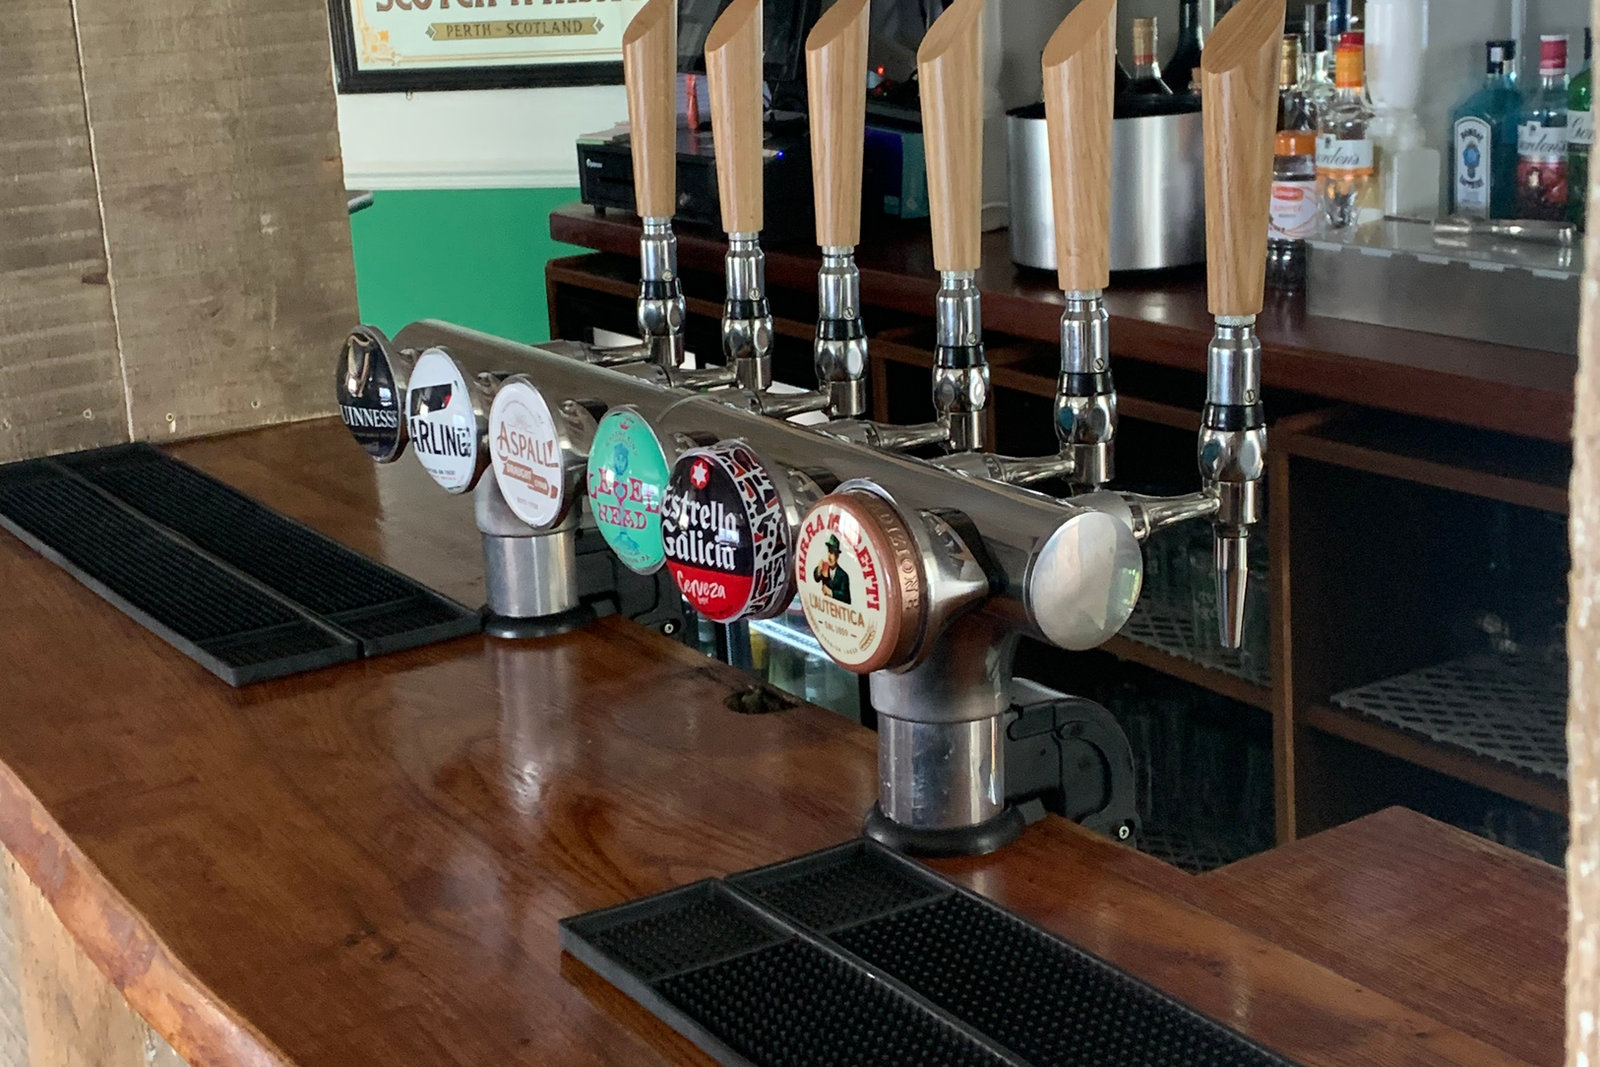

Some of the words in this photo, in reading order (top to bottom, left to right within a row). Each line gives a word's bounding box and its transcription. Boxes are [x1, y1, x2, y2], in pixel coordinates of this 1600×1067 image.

[446, 22, 492, 38] PERTH
[505, 19, 583, 36] SCOTLAND
[1317, 147, 1360, 165] ordon's
[340, 404, 397, 428] UINNESS
[411, 418, 471, 458] ARLING
[497, 421, 559, 467] ASPALL
[588, 468, 660, 514] LEVEL
[661, 486, 737, 532] Estrella
[598, 502, 648, 530] HEAD
[662, 519, 737, 571] Galicia
[799, 514, 826, 583] BIRRA
[827, 512, 880, 612] METTI
[677, 570, 727, 600] Cerveza
[809, 592, 865, 628] L'AUTENTICA
